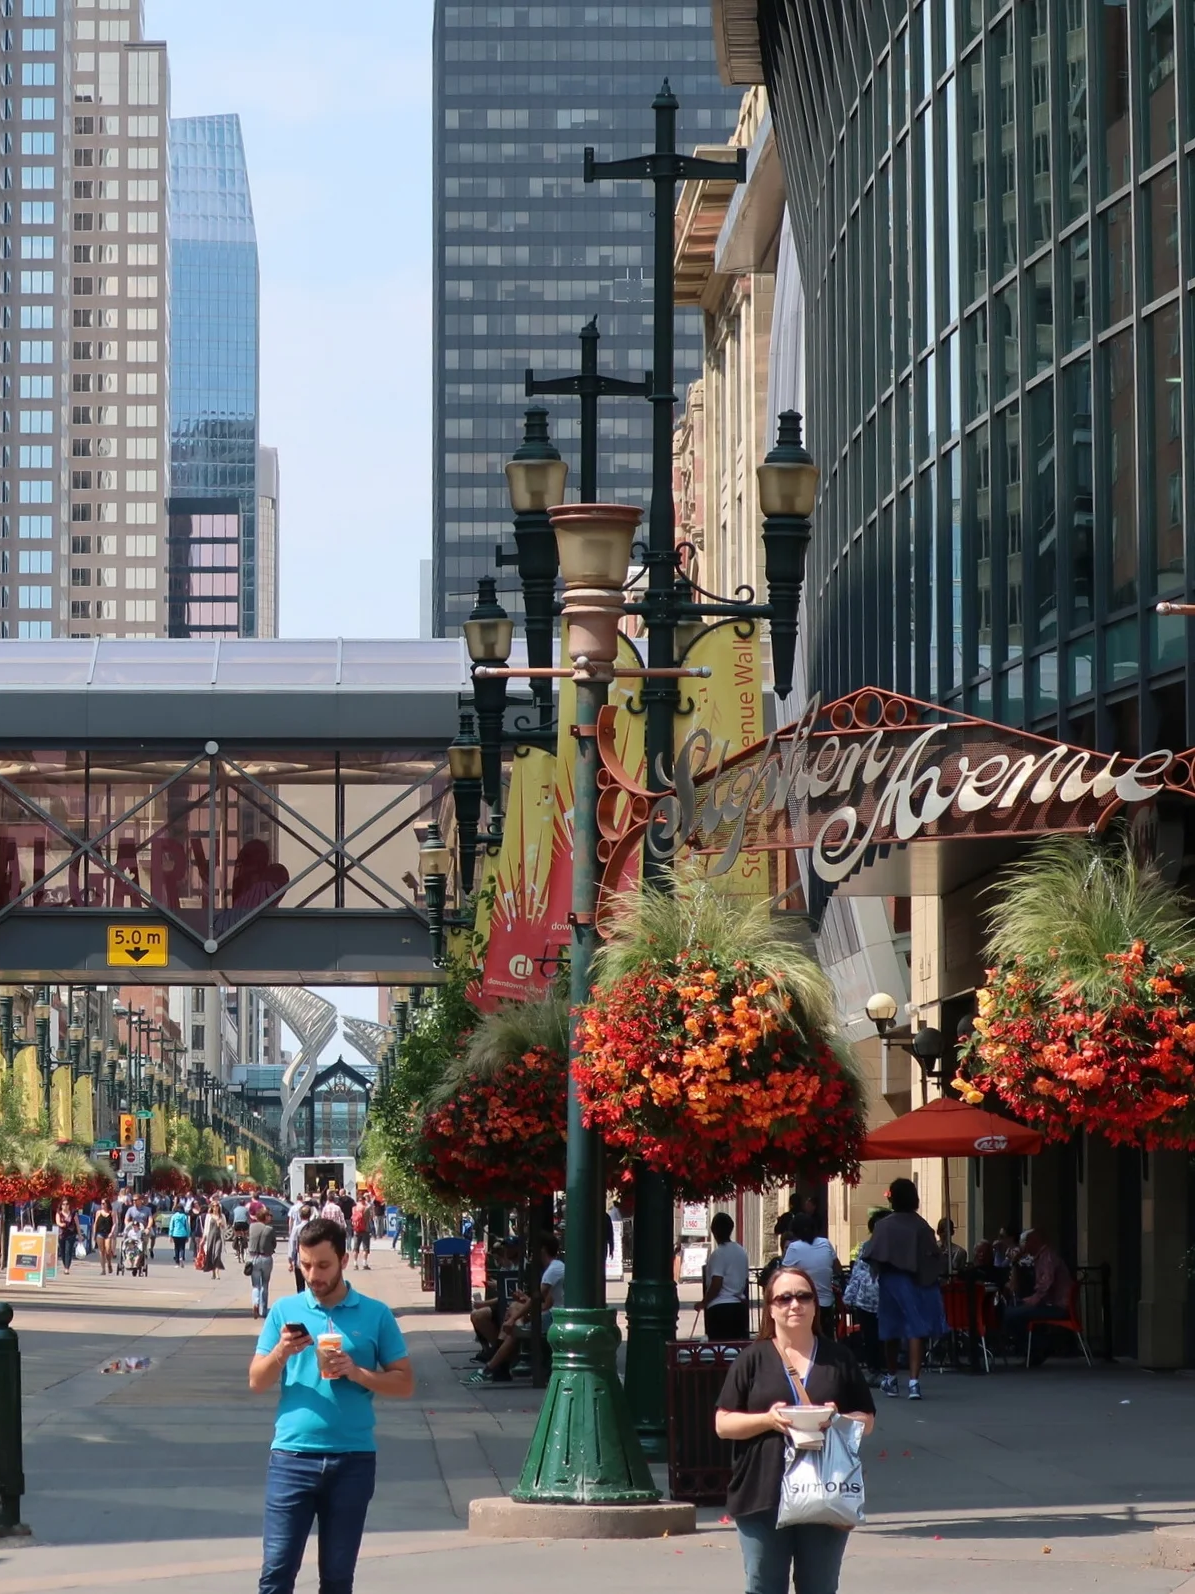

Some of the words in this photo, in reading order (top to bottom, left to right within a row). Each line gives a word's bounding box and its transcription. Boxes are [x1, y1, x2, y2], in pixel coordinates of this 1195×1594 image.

[733, 636, 754, 687] Walk
[647, 691, 895, 877] Stephen
[812, 722, 1174, 883] Avenue
[114, 930, 142, 945] 5.0
[147, 933, 161, 945] m
[487, 977, 525, 991] downtown
